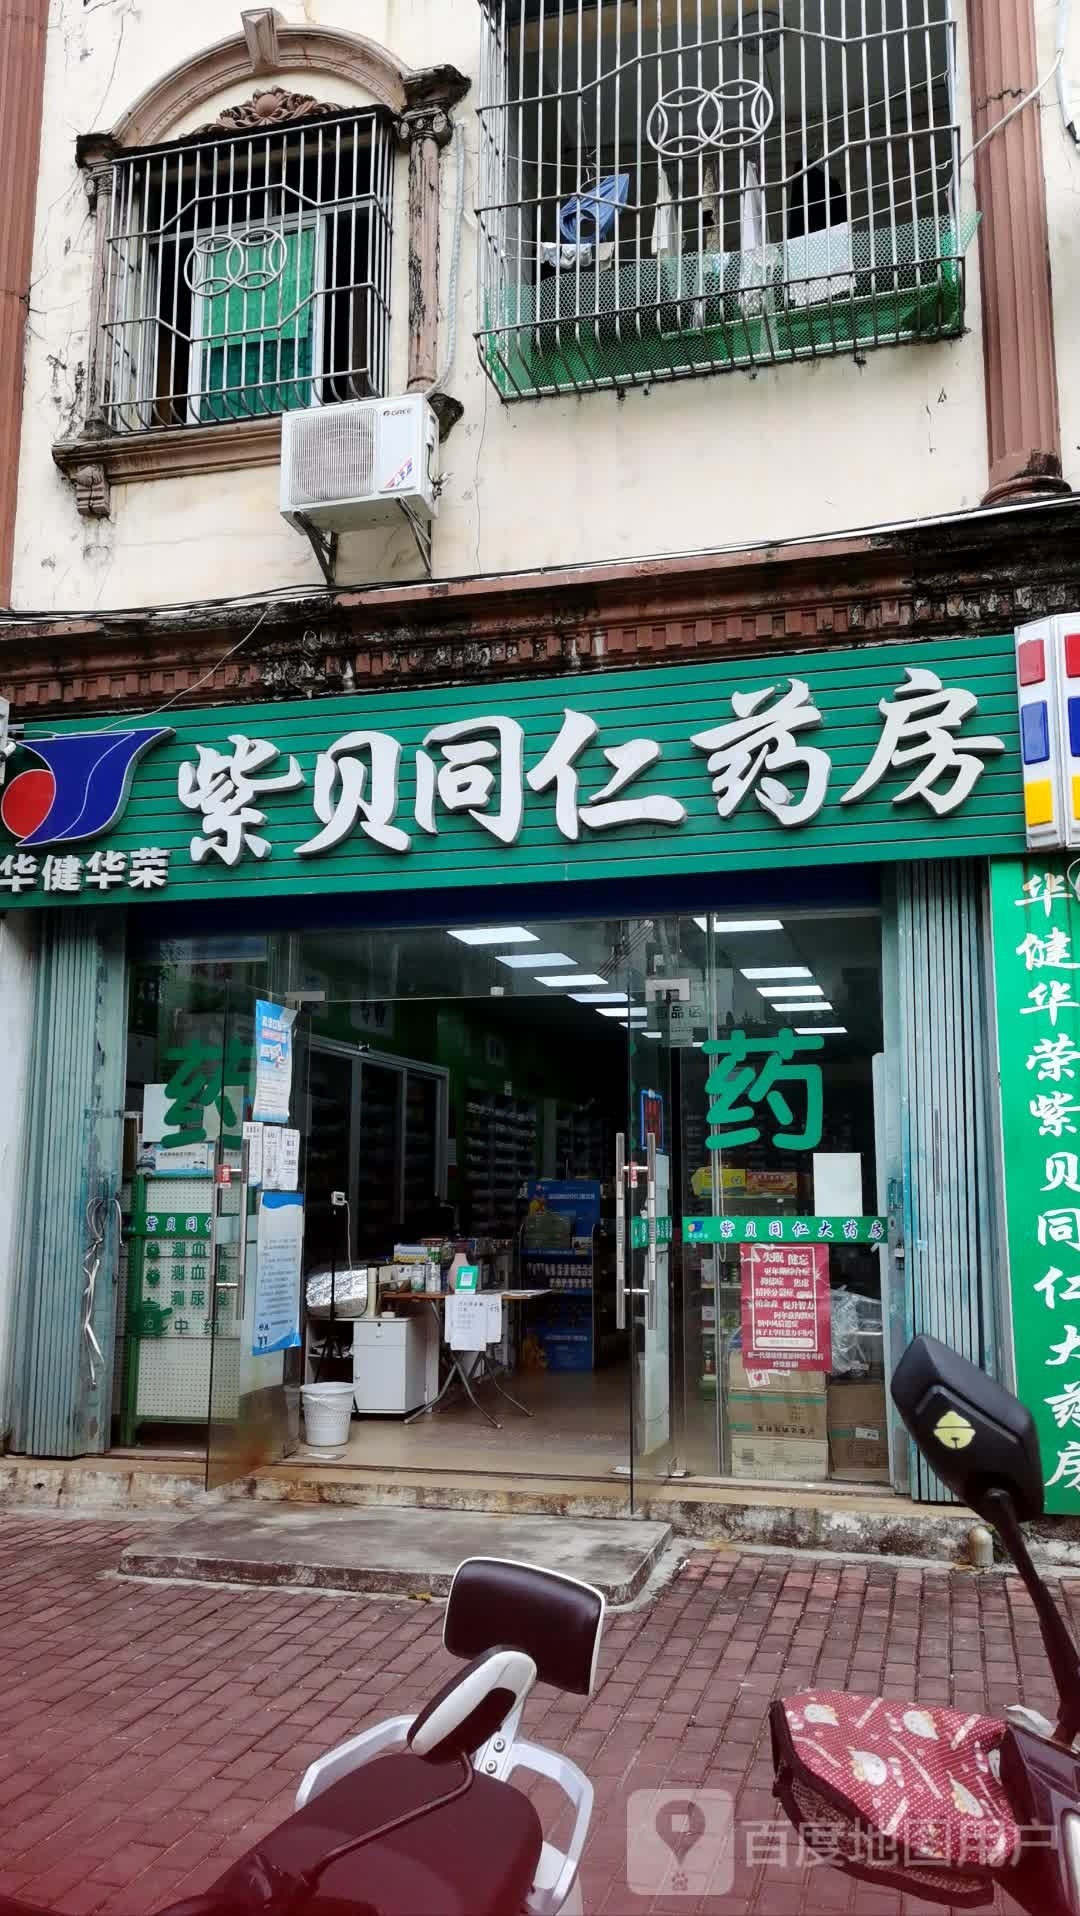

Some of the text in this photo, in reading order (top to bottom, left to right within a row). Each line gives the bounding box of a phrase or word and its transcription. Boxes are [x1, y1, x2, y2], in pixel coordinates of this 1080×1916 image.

[178, 667, 1006, 866] 紫贝同仁药房
[0, 846, 170, 893] 华健华荣
[701, 1028, 825, 1150] 药
[719, 1219, 885, 1240] 紫贝同仁大药房
